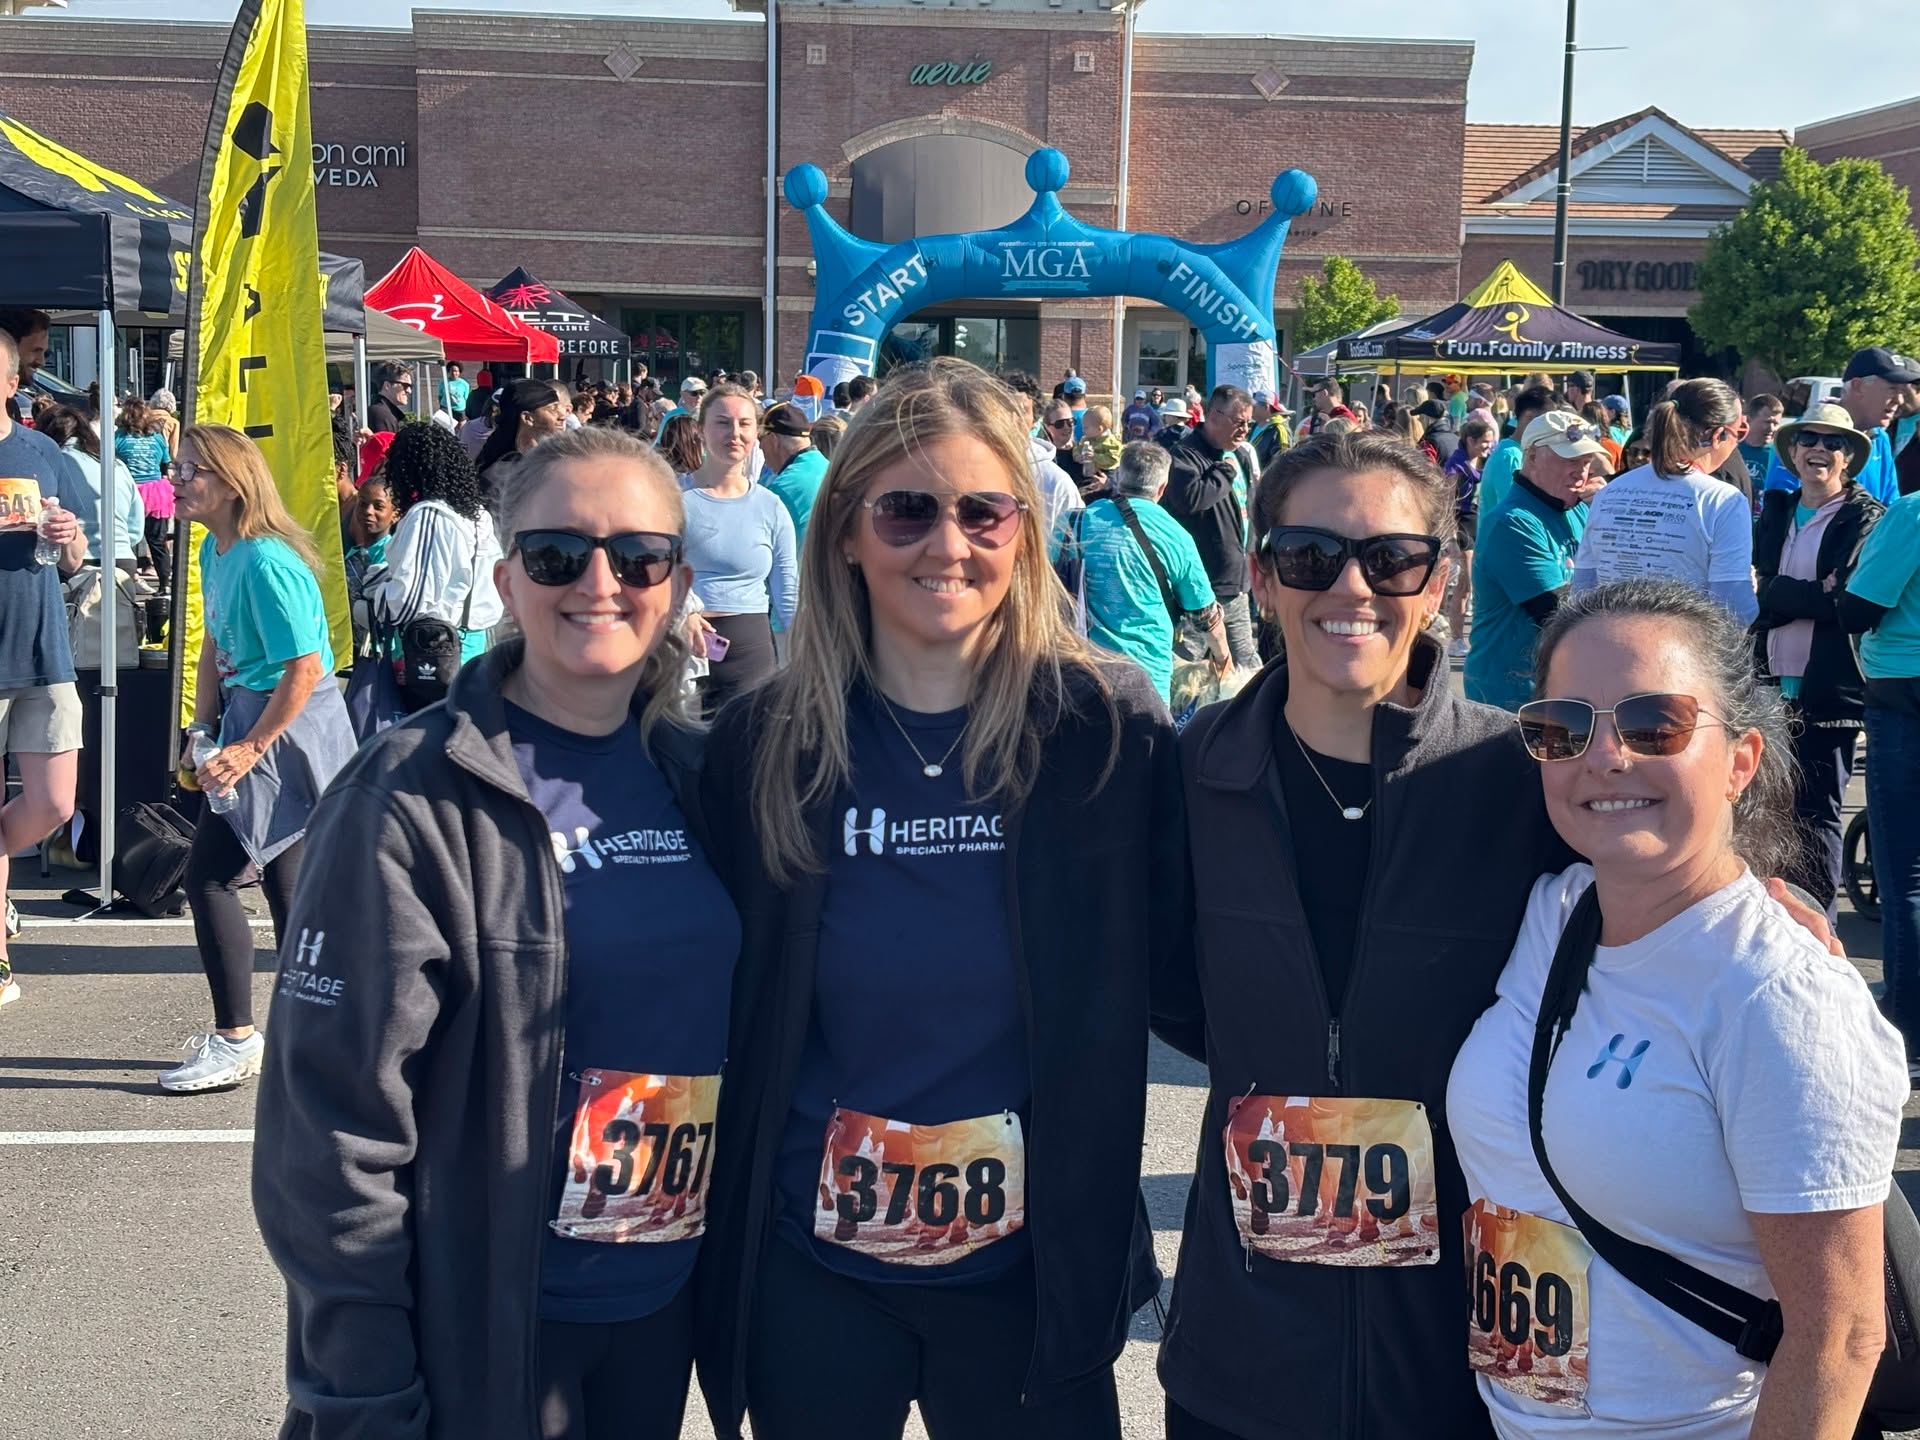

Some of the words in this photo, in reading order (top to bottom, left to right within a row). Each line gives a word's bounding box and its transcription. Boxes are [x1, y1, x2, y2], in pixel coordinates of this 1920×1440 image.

[911, 53, 992, 86] aerie
[311, 143, 345, 165] on
[352, 140, 405, 167] ami
[313, 168, 379, 188] VEDA
[1236, 199, 1353, 217] OFINE
[1001, 247, 1092, 278] MGA
[1576, 260, 1632, 291] DRY
[1635, 260, 1697, 292] GOOD
[843, 252, 928, 327] START
[1168, 262, 1258, 340] FINISH
[552, 324, 590, 332] CLINIC
[558, 339, 619, 354] BEFORE
[1447, 339, 1628, 361] Fun.Family.Fitness
[594, 829, 689, 855] HERITAGE
[890, 815, 1004, 843] HERITAG
[612, 855, 650, 864] SPECIALTY
[896, 845, 955, 855] SPECIALTY
[959, 841, 1006, 852] PHARMA
[595, 1119, 714, 1196] 3767
[836, 1155, 1006, 1226] 3768
[1248, 1140, 1411, 1220] 3779
[1468, 1250, 1574, 1357] 669
